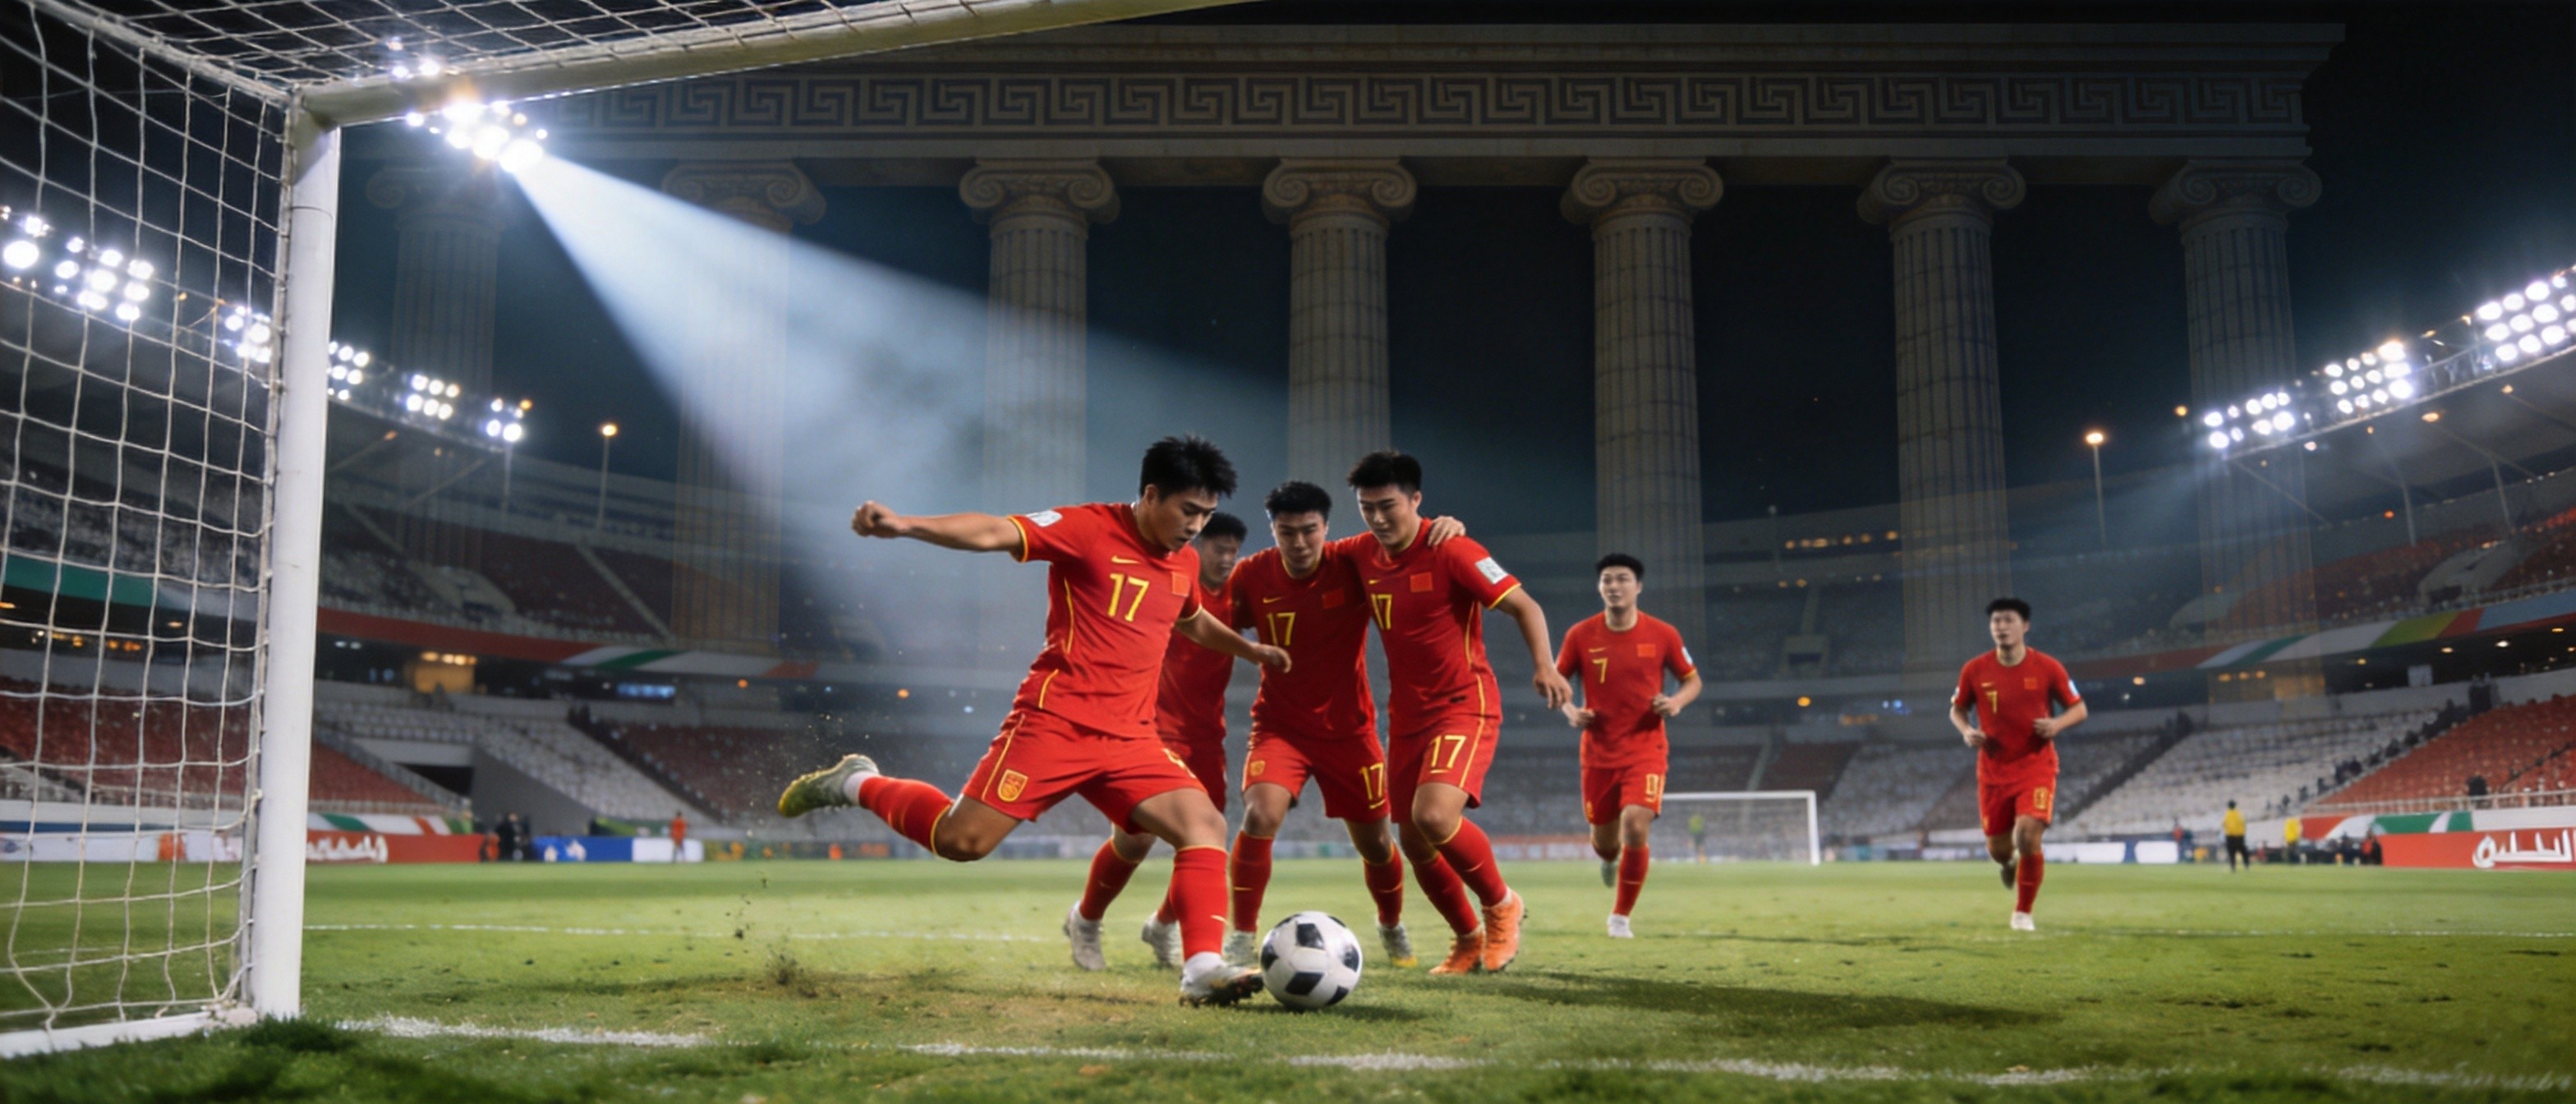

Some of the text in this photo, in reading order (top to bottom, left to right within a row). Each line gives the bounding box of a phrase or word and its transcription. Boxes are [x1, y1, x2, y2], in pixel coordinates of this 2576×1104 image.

[1108, 573, 1149, 622] 17
[1371, 594, 1392, 630] 17
[1267, 612, 1295, 646] 17
[1592, 658, 1608, 683] 7
[1430, 735, 1466, 768] 17
[1359, 762, 1384, 800] 17
